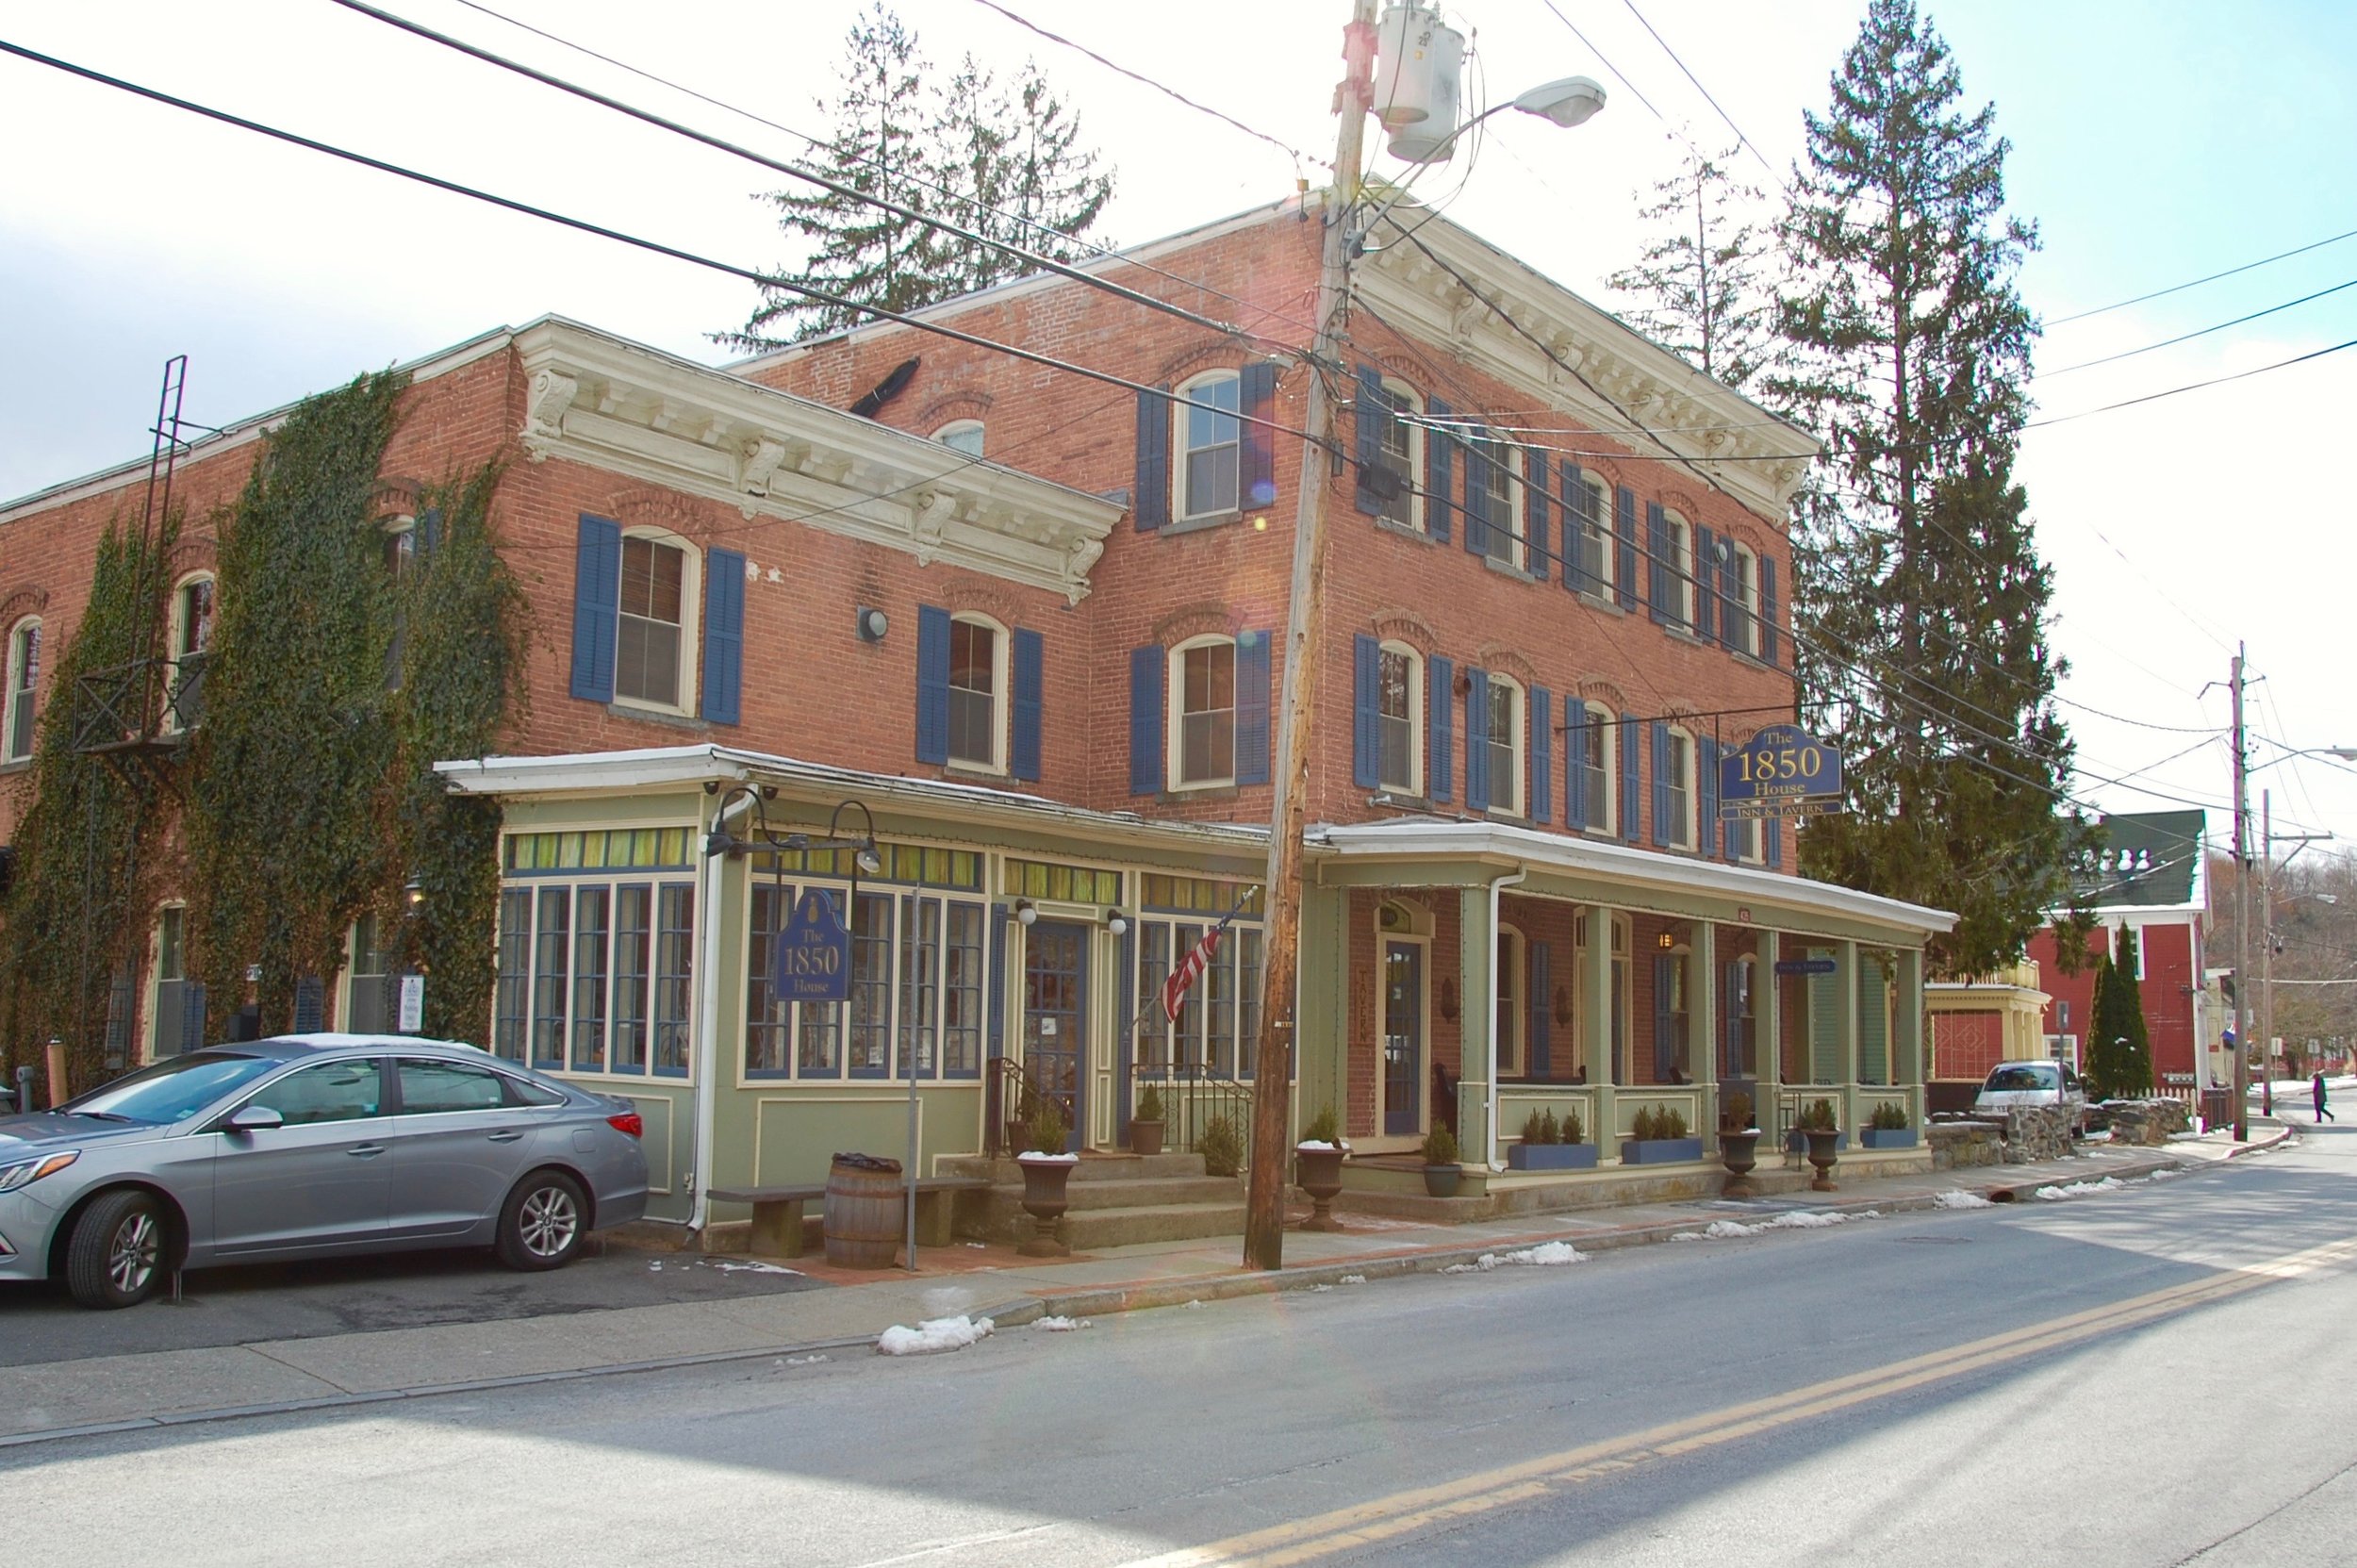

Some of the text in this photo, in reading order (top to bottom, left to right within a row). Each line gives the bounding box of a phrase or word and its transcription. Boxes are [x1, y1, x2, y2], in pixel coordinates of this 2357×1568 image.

[1763, 732, 1793, 745] The
[1739, 747, 1821, 782] 1850
[1755, 782, 1805, 797] House
[1737, 804, 1824, 818] INN & TAVERN
[801, 929, 825, 943] The
[784, 946, 839, 976] 1850
[794, 979, 829, 994] House
[1358, 970, 1368, 1043] TAVERN
